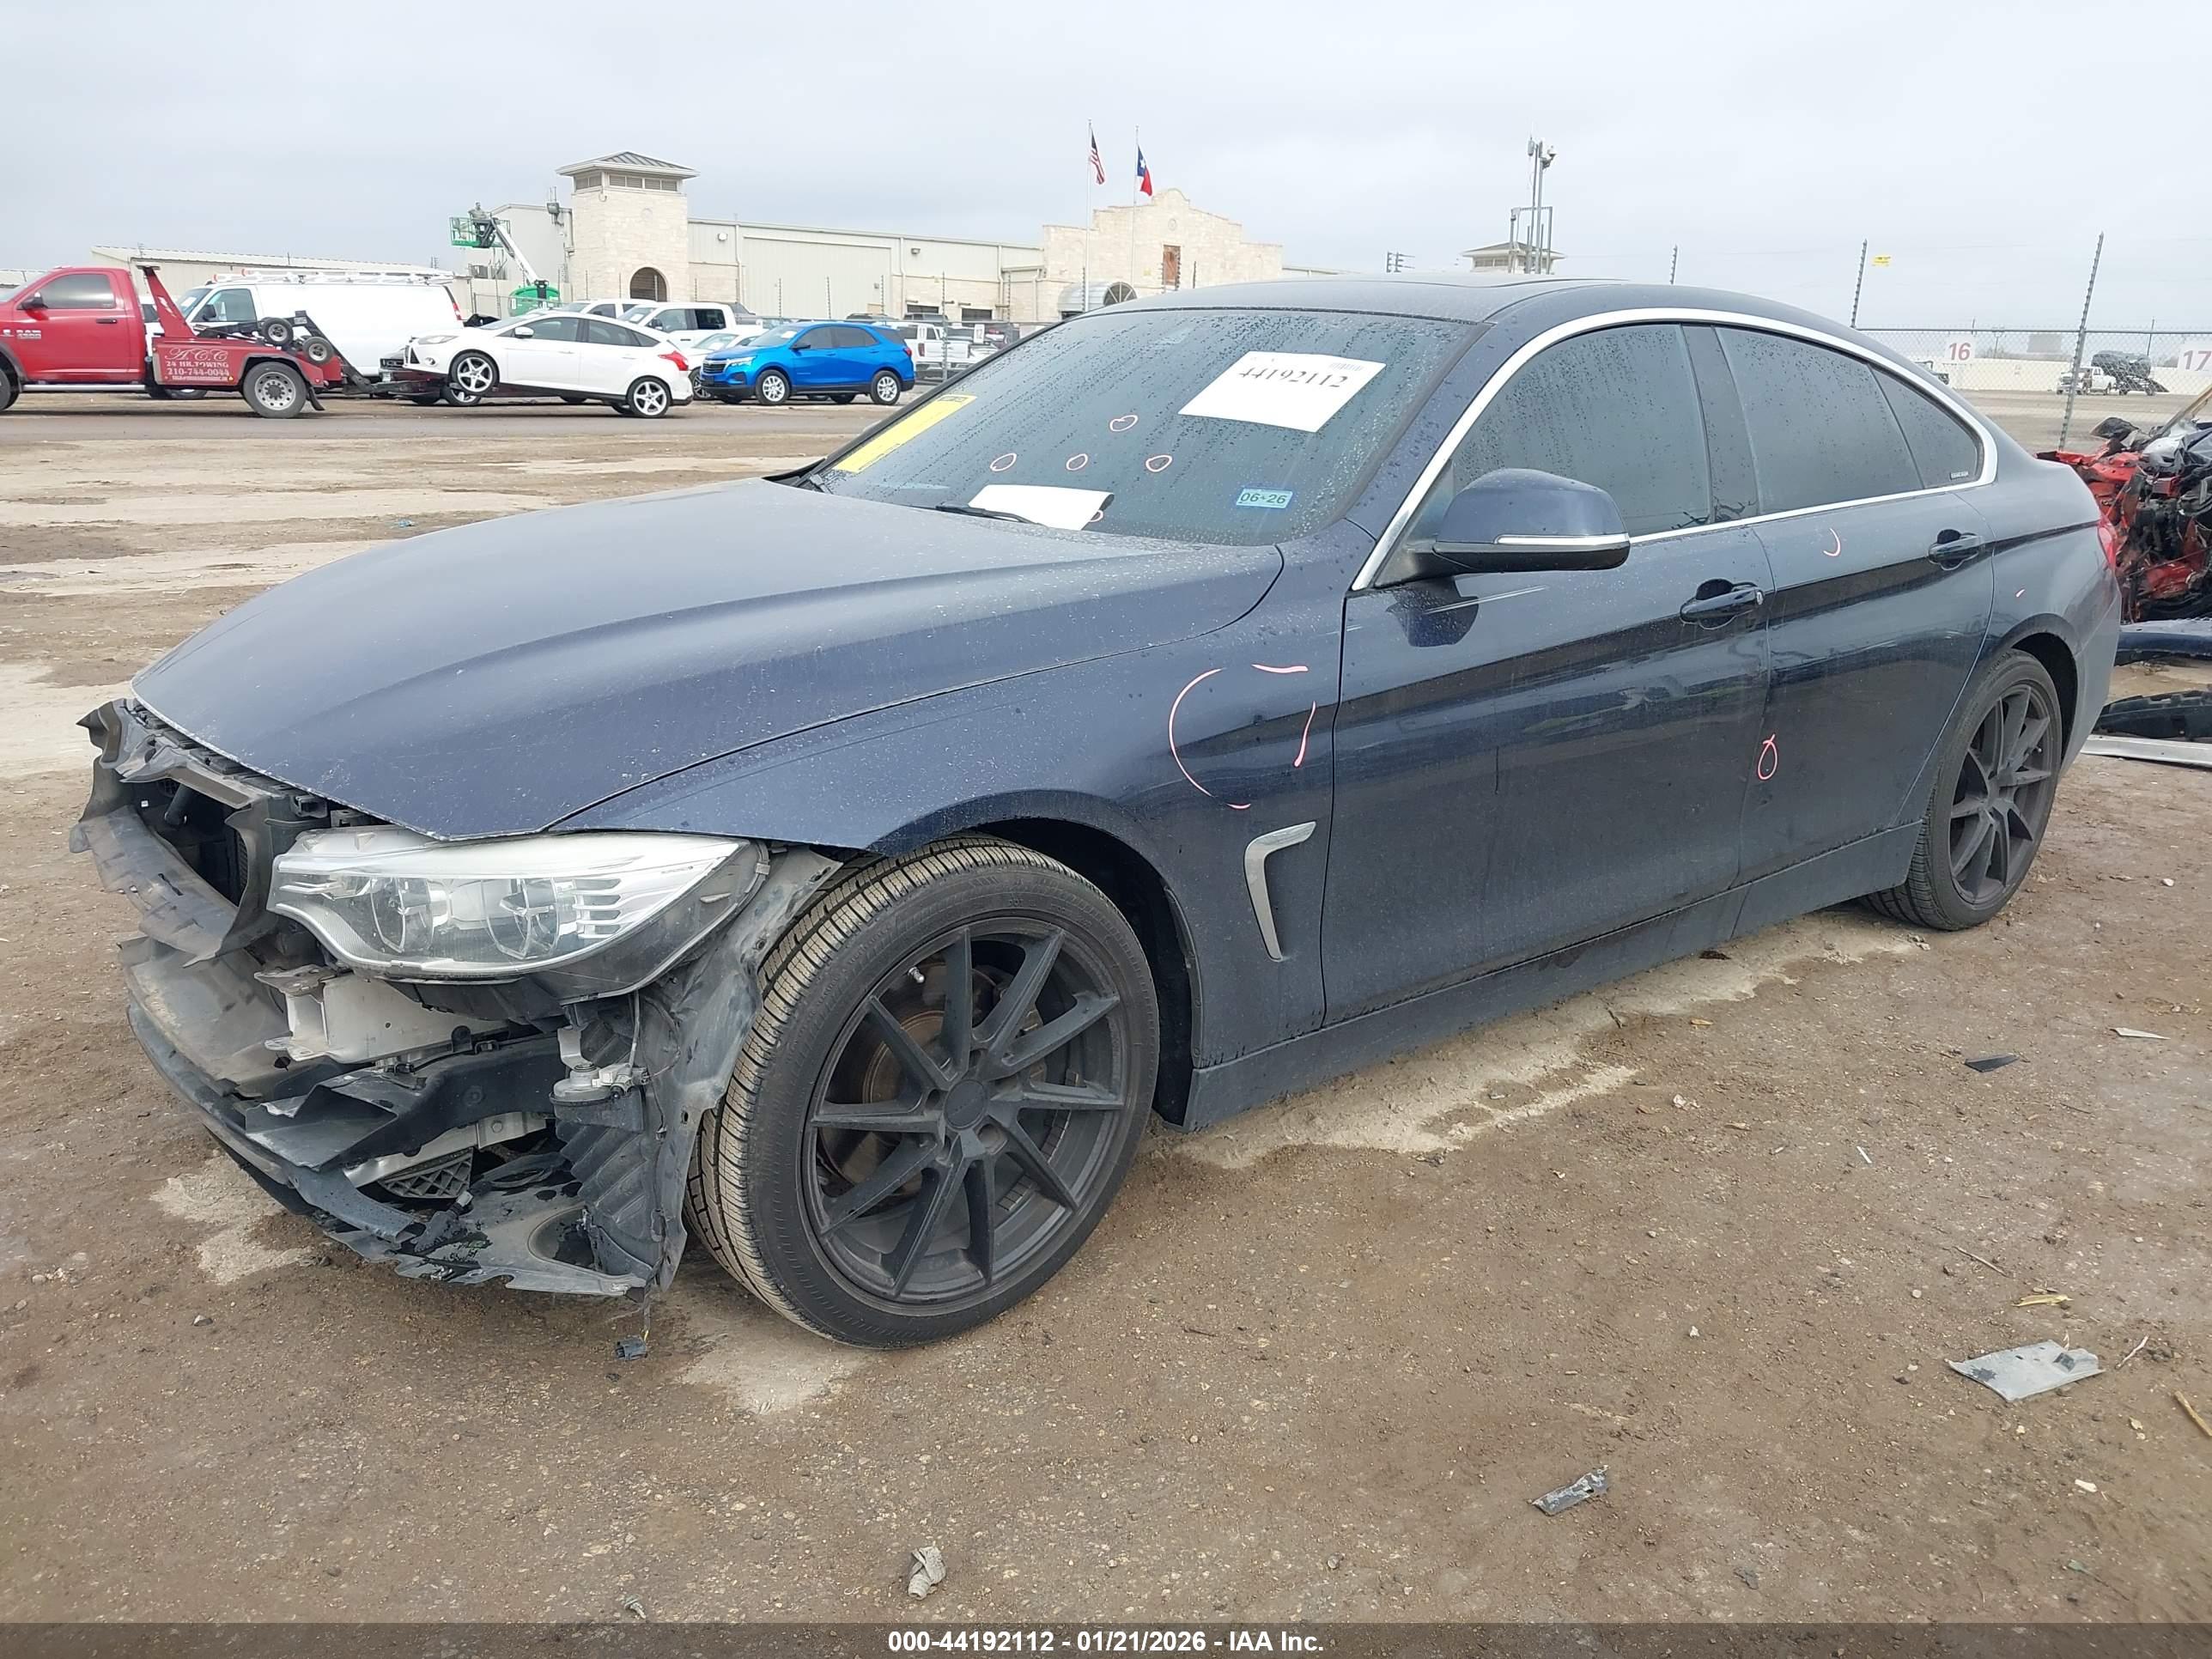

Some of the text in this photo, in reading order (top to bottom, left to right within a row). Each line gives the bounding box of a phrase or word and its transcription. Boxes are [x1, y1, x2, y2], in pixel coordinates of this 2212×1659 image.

[1949, 343, 1971, 361] 16
[2184, 350, 2212, 371] 17
[1238, 367, 1348, 388] 44192112
